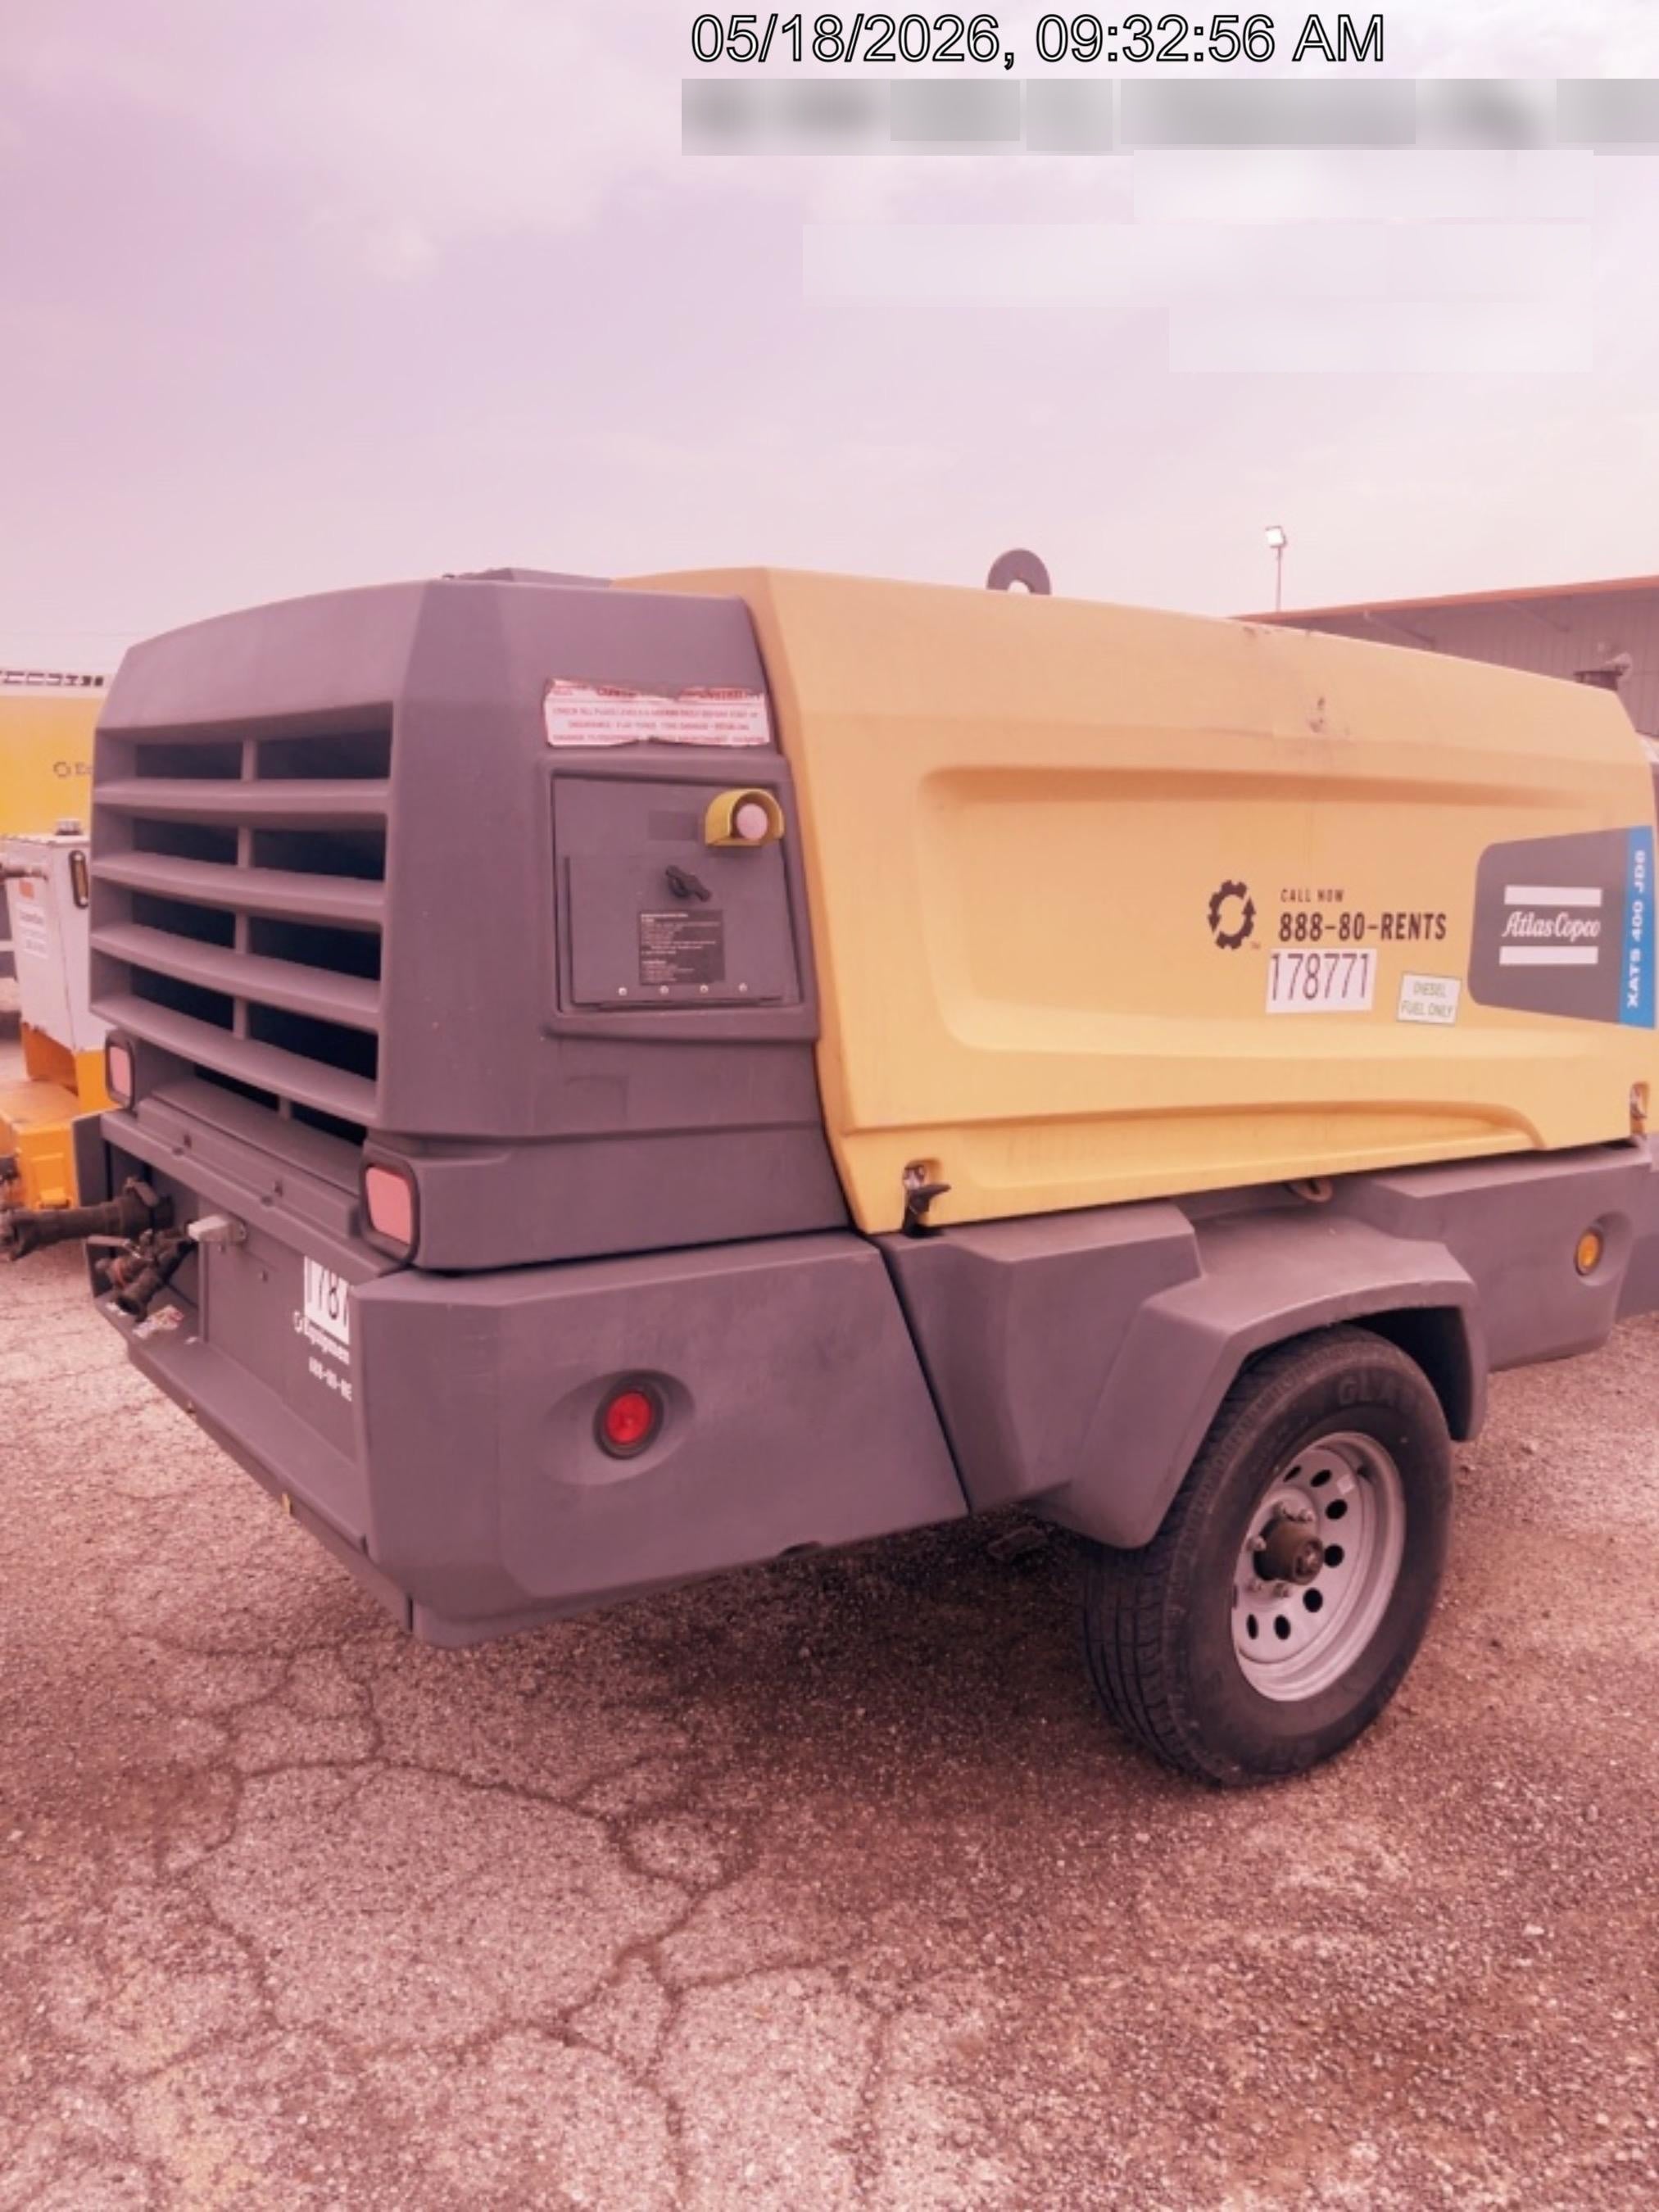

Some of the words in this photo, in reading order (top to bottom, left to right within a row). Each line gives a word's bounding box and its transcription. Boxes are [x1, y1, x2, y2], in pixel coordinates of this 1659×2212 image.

[1280, 888, 1312, 903] CALL
[1317, 888, 1344, 903] NOW
[1278, 911, 1448, 942] 888-80-RENTS
[1631, 900, 1644, 942] 400
[1270, 952, 1369, 1001] 178771
[1412, 981, 1448, 998] DIESEL
[1401, 999, 1426, 1016] FUEL
[1428, 1002, 1454, 1018] ONLY
